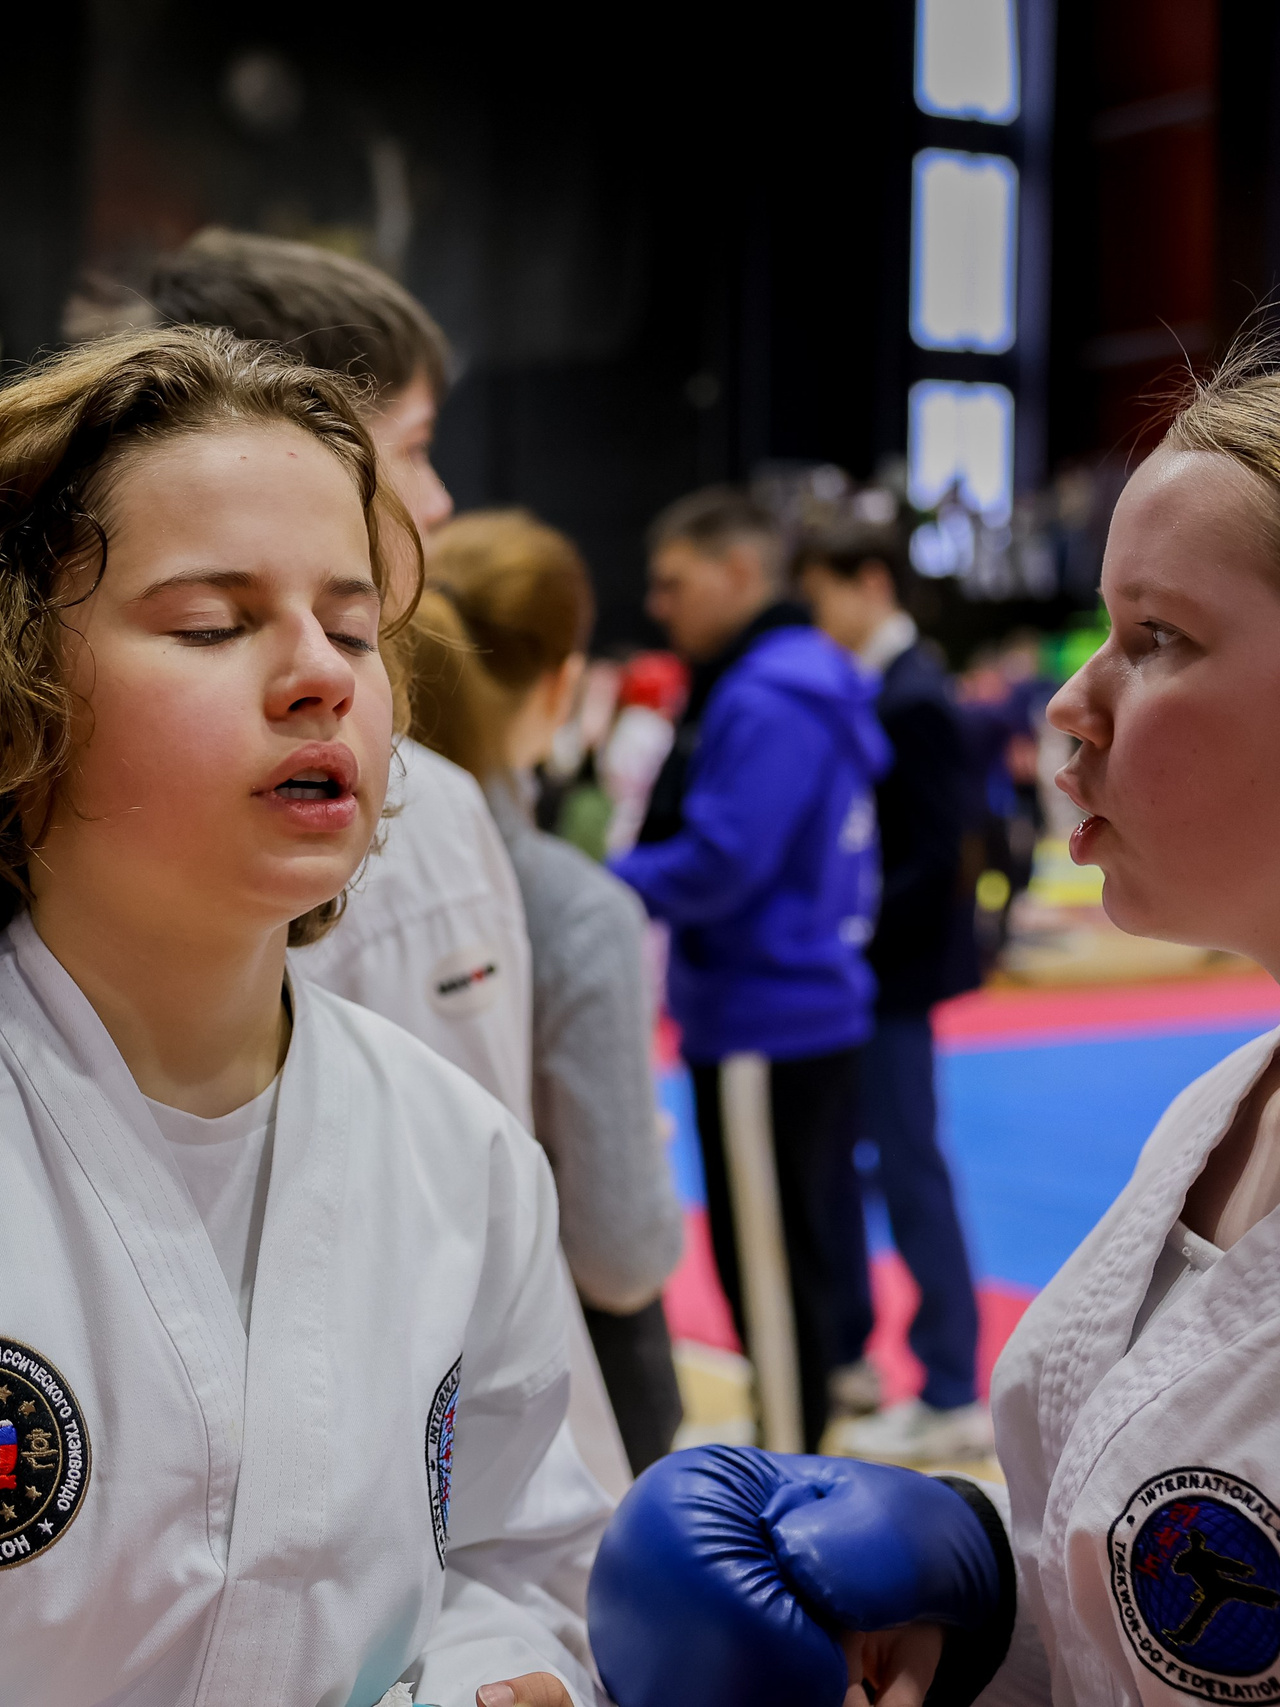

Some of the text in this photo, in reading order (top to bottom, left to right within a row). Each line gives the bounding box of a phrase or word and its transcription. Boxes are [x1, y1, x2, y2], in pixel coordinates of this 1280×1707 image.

[57, 1419, 83, 1512] ТХЭКВОНДО
[1138, 1474, 1273, 1529] INTERNATIONAL
[1114, 1541, 1280, 1699] TAEKWON-DO FEDERATION
